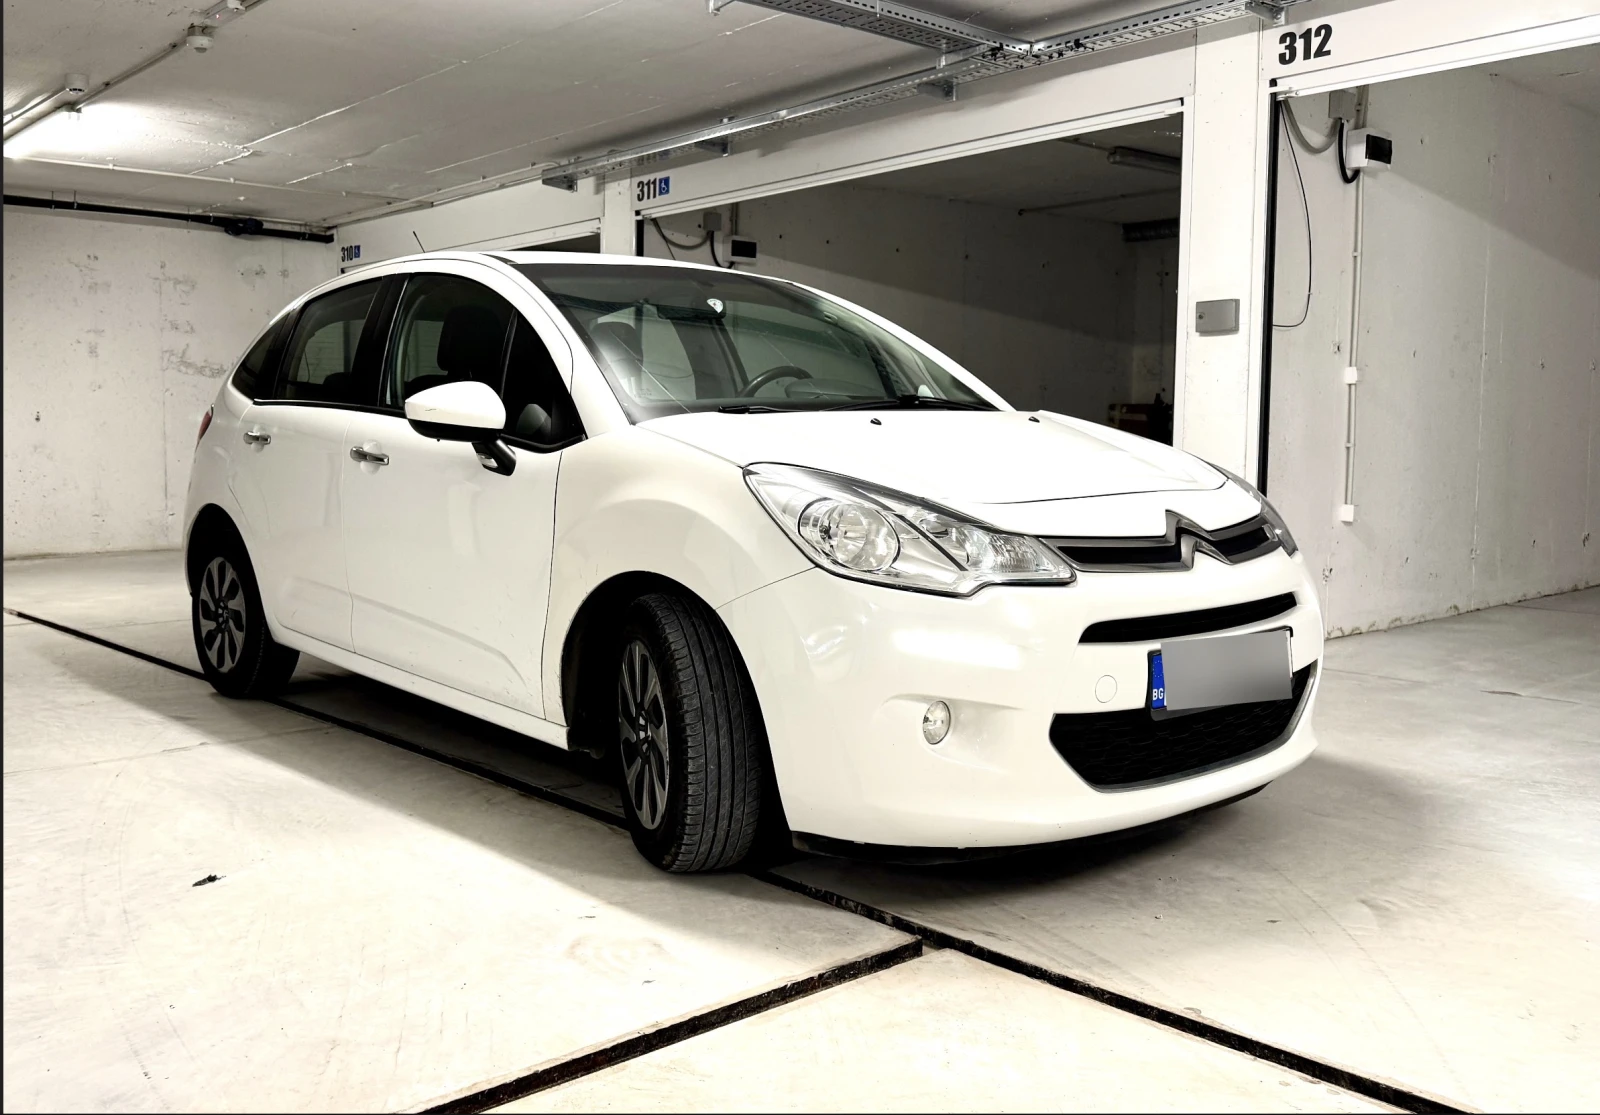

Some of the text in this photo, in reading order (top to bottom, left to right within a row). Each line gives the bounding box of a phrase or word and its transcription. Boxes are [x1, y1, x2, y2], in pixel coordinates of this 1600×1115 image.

[1278, 24, 1332, 65] 312
[637, 177, 657, 202] 311
[341, 245, 353, 262] 310
[1152, 688, 1164, 701] BG
